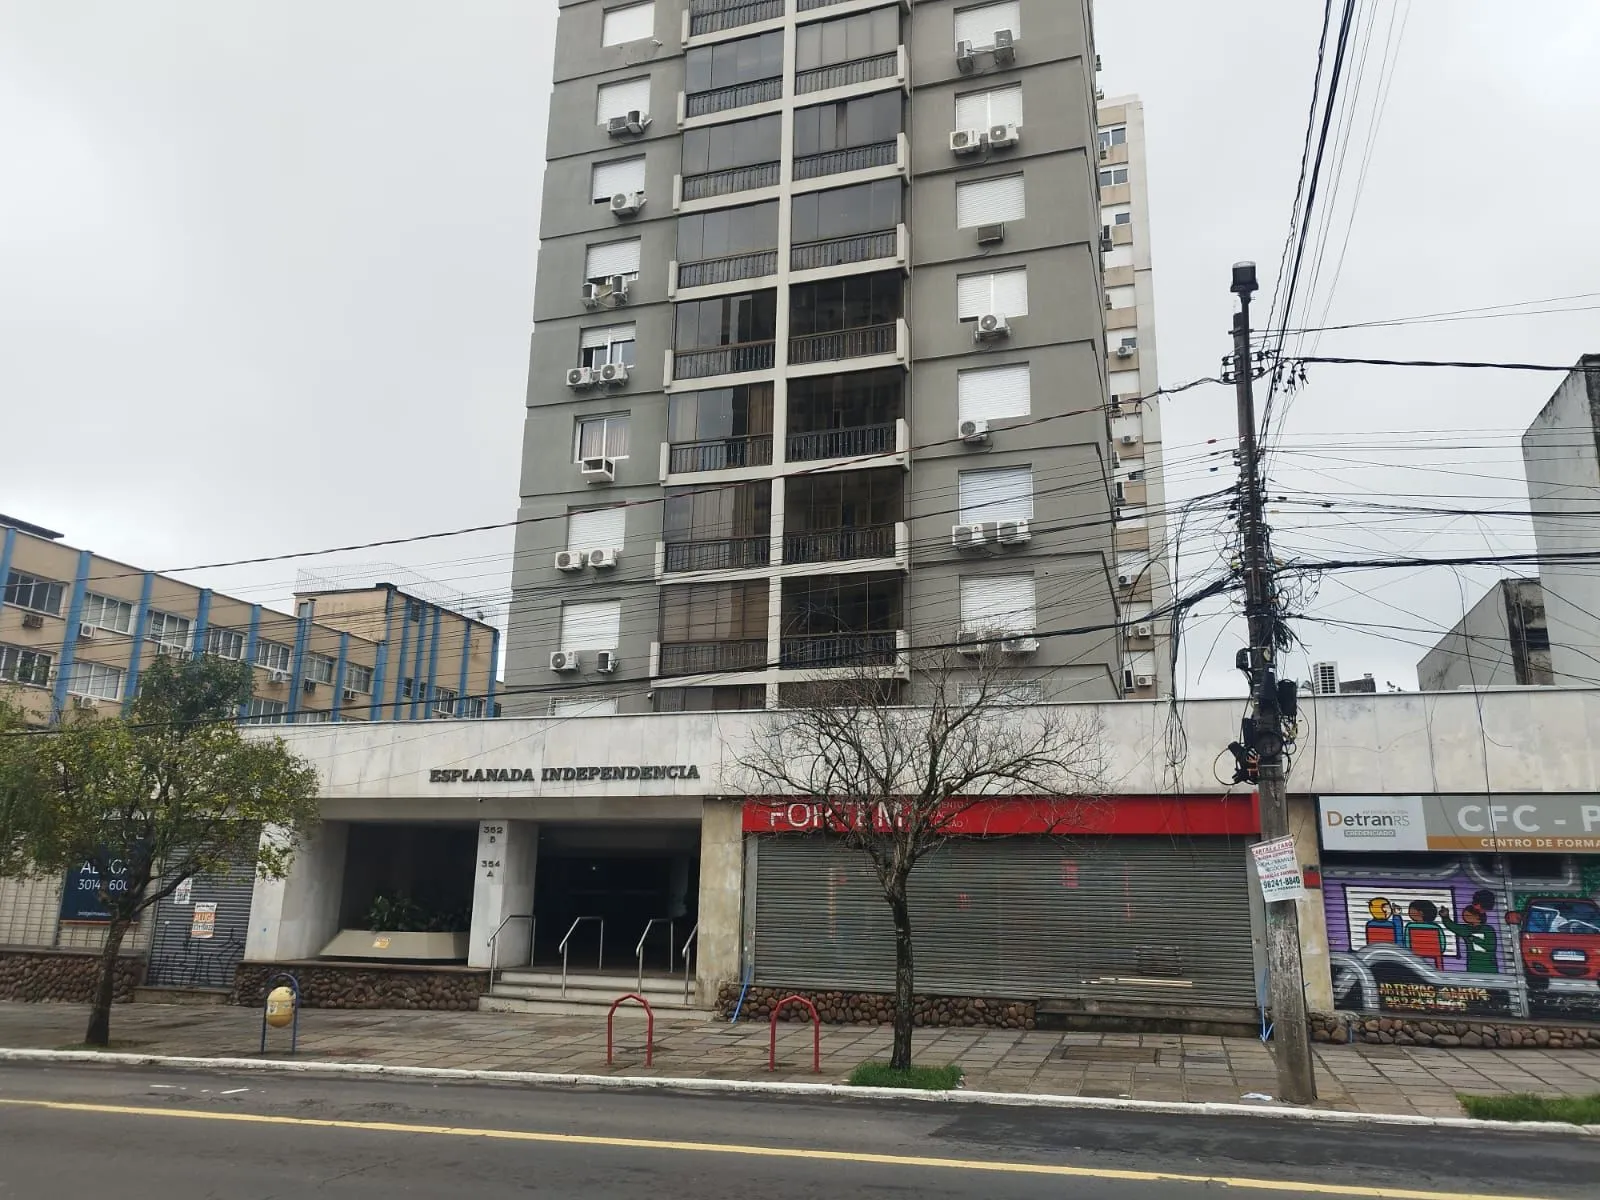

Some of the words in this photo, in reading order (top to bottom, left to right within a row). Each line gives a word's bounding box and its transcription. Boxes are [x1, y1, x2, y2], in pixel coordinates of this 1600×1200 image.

[429, 768, 535, 783] ESPLANADA
[541, 765, 700, 782] INDEPENDENCIA
[1457, 805, 1540, 832] CFC
[1480, 838, 1532, 848] CENTRO
[1536, 839, 1553, 847] DE
